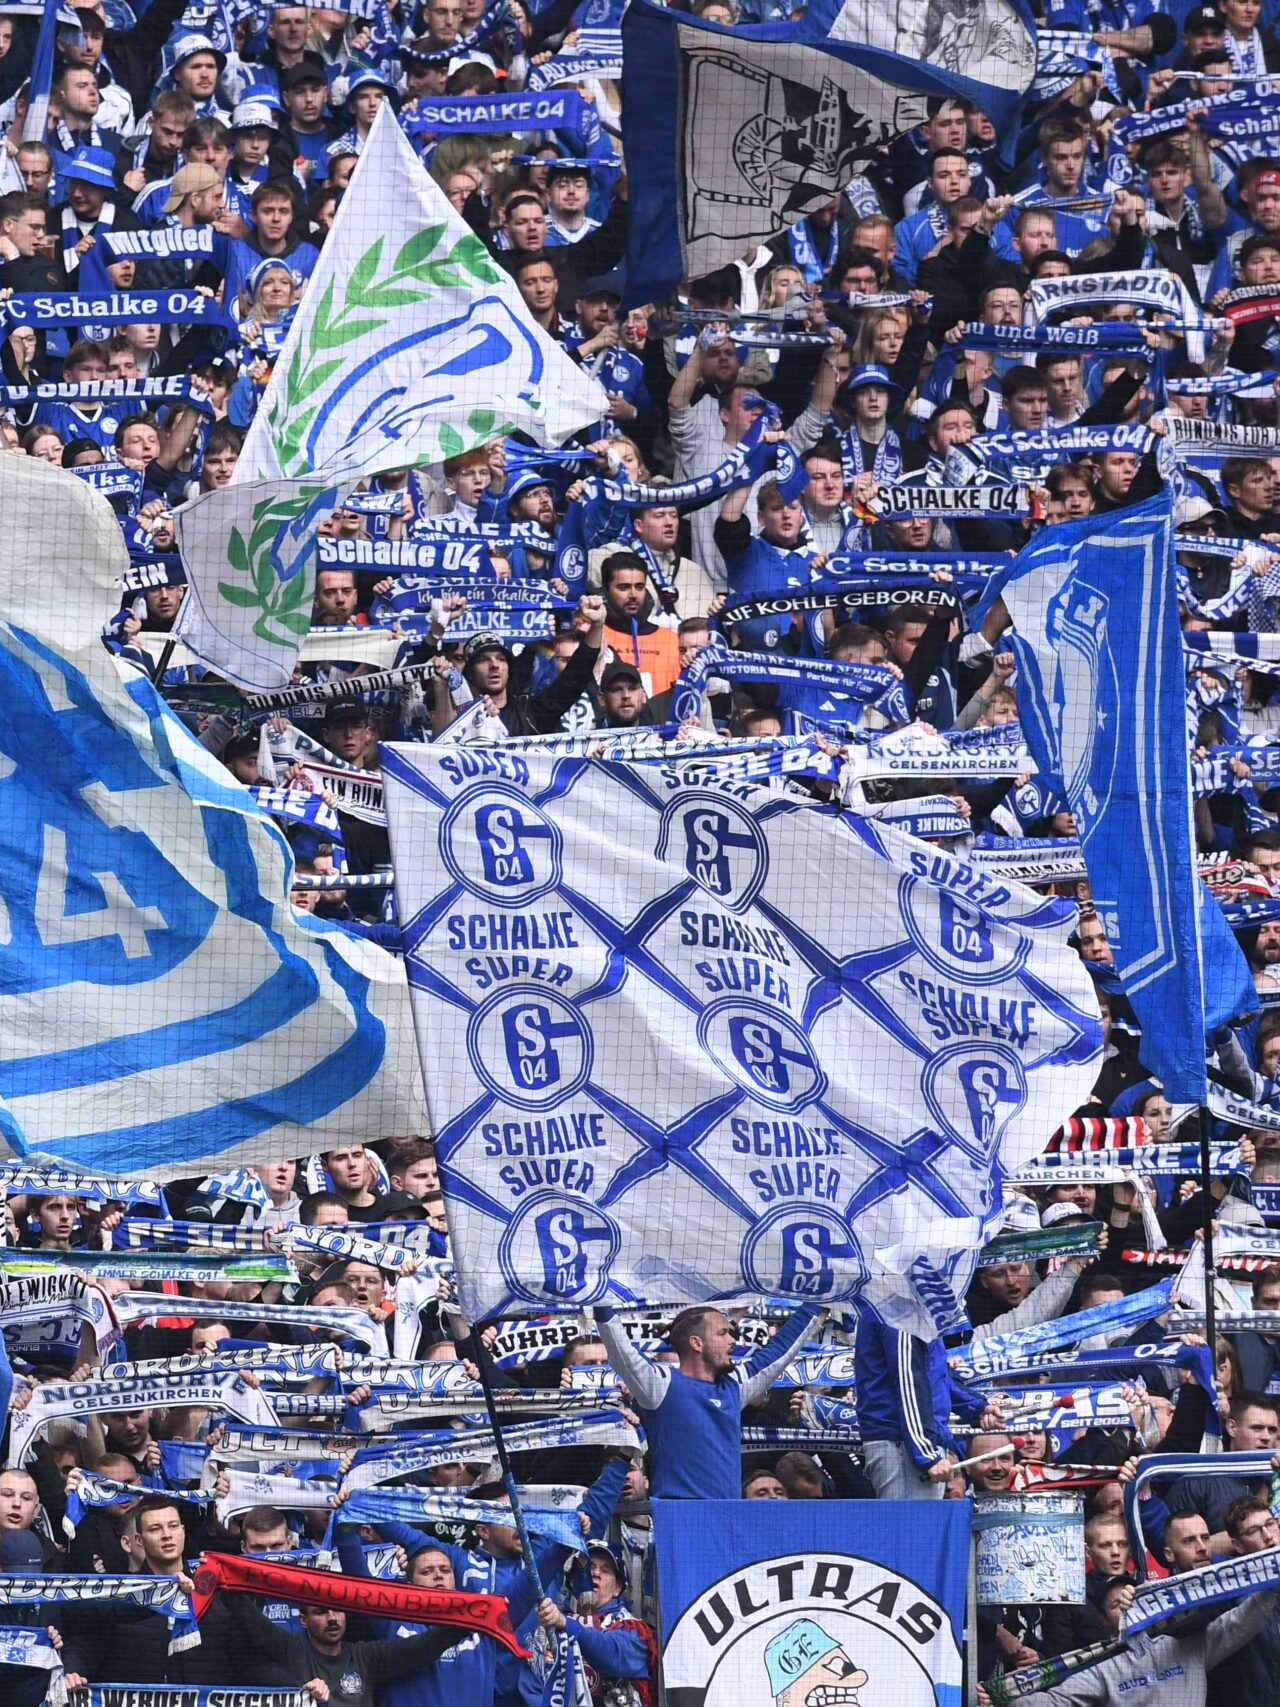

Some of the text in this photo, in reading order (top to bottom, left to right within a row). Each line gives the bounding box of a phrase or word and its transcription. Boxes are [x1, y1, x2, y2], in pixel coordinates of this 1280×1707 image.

[423, 99, 565, 123] SCHALKE 04
[37, 297, 159, 319] Schalke
[167, 294, 207, 315] 04
[993, 324, 1099, 345] und Weiß
[981, 424, 1142, 455] FC Schalke 04
[882, 482, 1020, 516] SCHALKE 04
[320, 537, 482, 574] Schalke 04
[760, 595, 838, 615] KOHLE
[844, 590, 956, 607] GEBOREN
[523, 611, 547, 628] 04
[438, 750, 531, 787] SUPER
[889, 758, 1019, 771] GELSENKIRCHEN
[665, 769, 762, 800] SUPER
[495, 856, 525, 881] 04
[696, 863, 722, 891] 04
[910, 851, 1011, 909] SUPER
[447, 911, 579, 951] SCHALKE
[681, 910, 792, 967] SCHALKE
[951, 927, 983, 958] 04
[464, 956, 575, 991] SUPER
[695, 956, 793, 1011] SUPER
[520, 1055, 549, 1084] 04
[482, 1113, 607, 1158] SCHALKE
[499, 1158, 595, 1197] SUPER
[749, 1160, 841, 1205] SUPER
[555, 1262, 579, 1293] 04
[791, 1272, 822, 1294] 04
[1134, 1342, 1180, 1359] 04
[72, 1388, 223, 1409] GELSENKIRCHEN
[694, 1561, 942, 1647] ULTRAS
